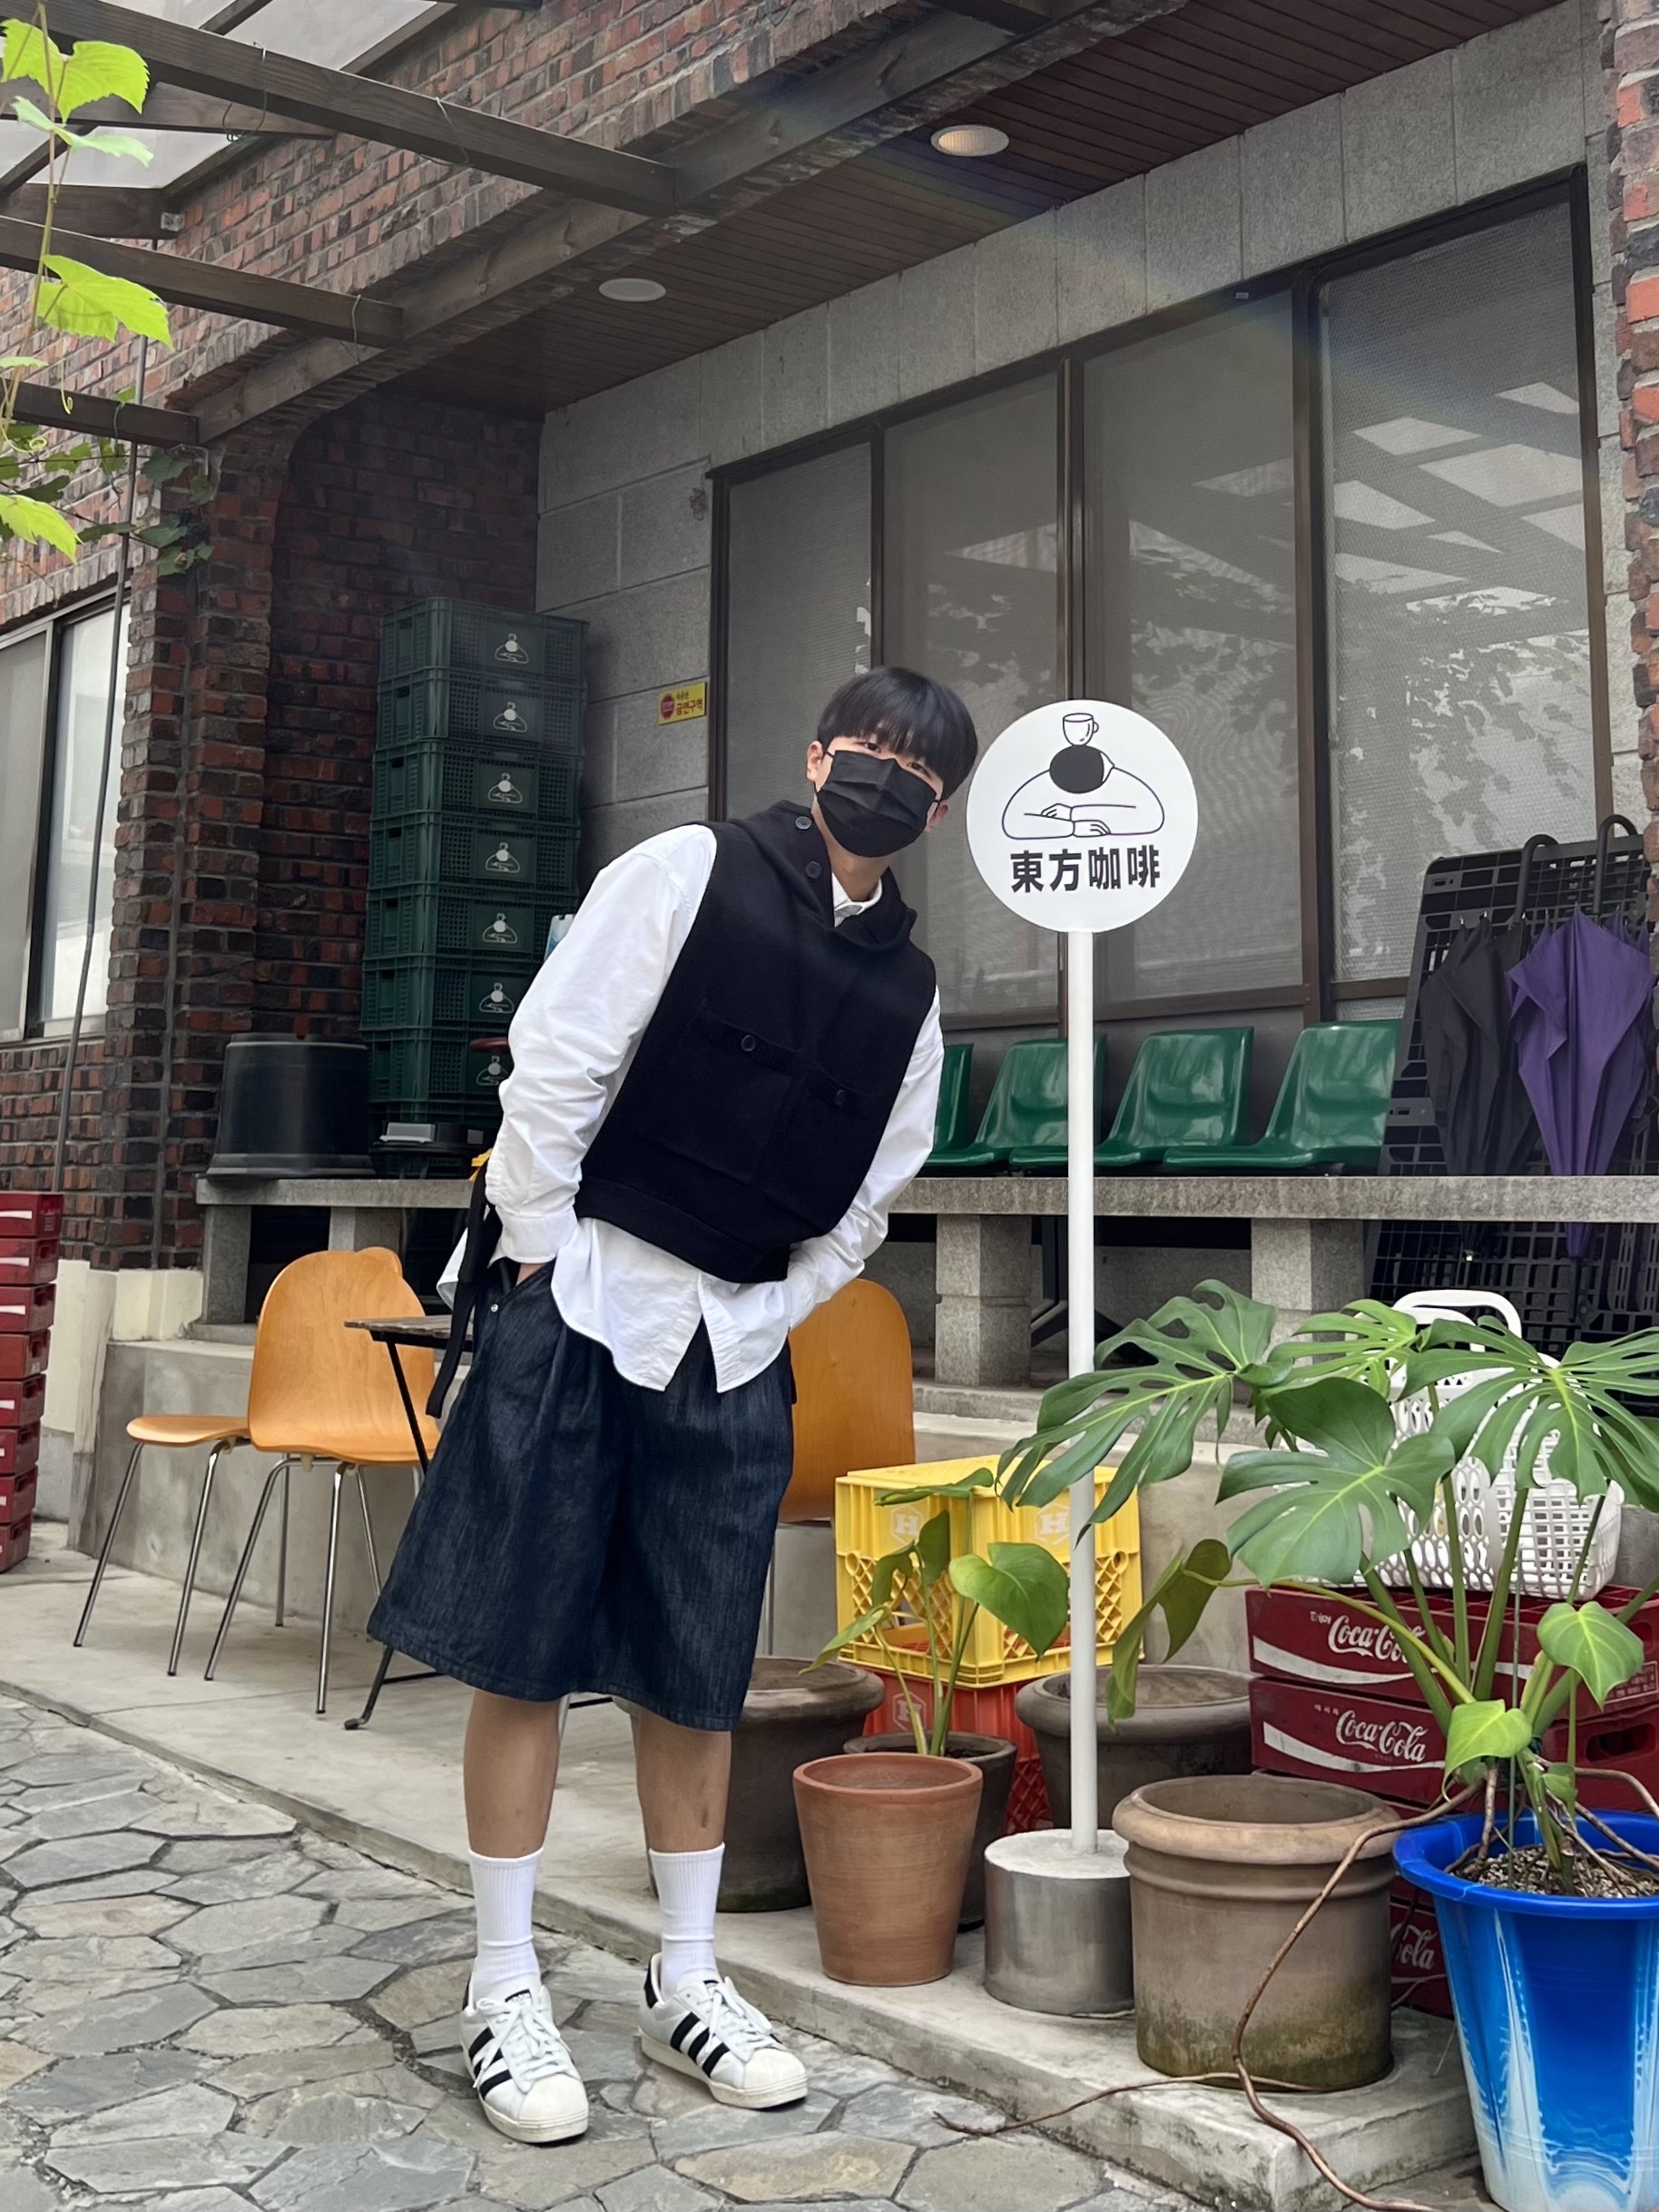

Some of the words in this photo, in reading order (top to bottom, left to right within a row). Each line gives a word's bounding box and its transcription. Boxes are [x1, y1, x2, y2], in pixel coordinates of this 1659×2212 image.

[1010, 844, 1161, 893] 東方咖啡
[1336, 1709, 1428, 1763] Coca-Cola
